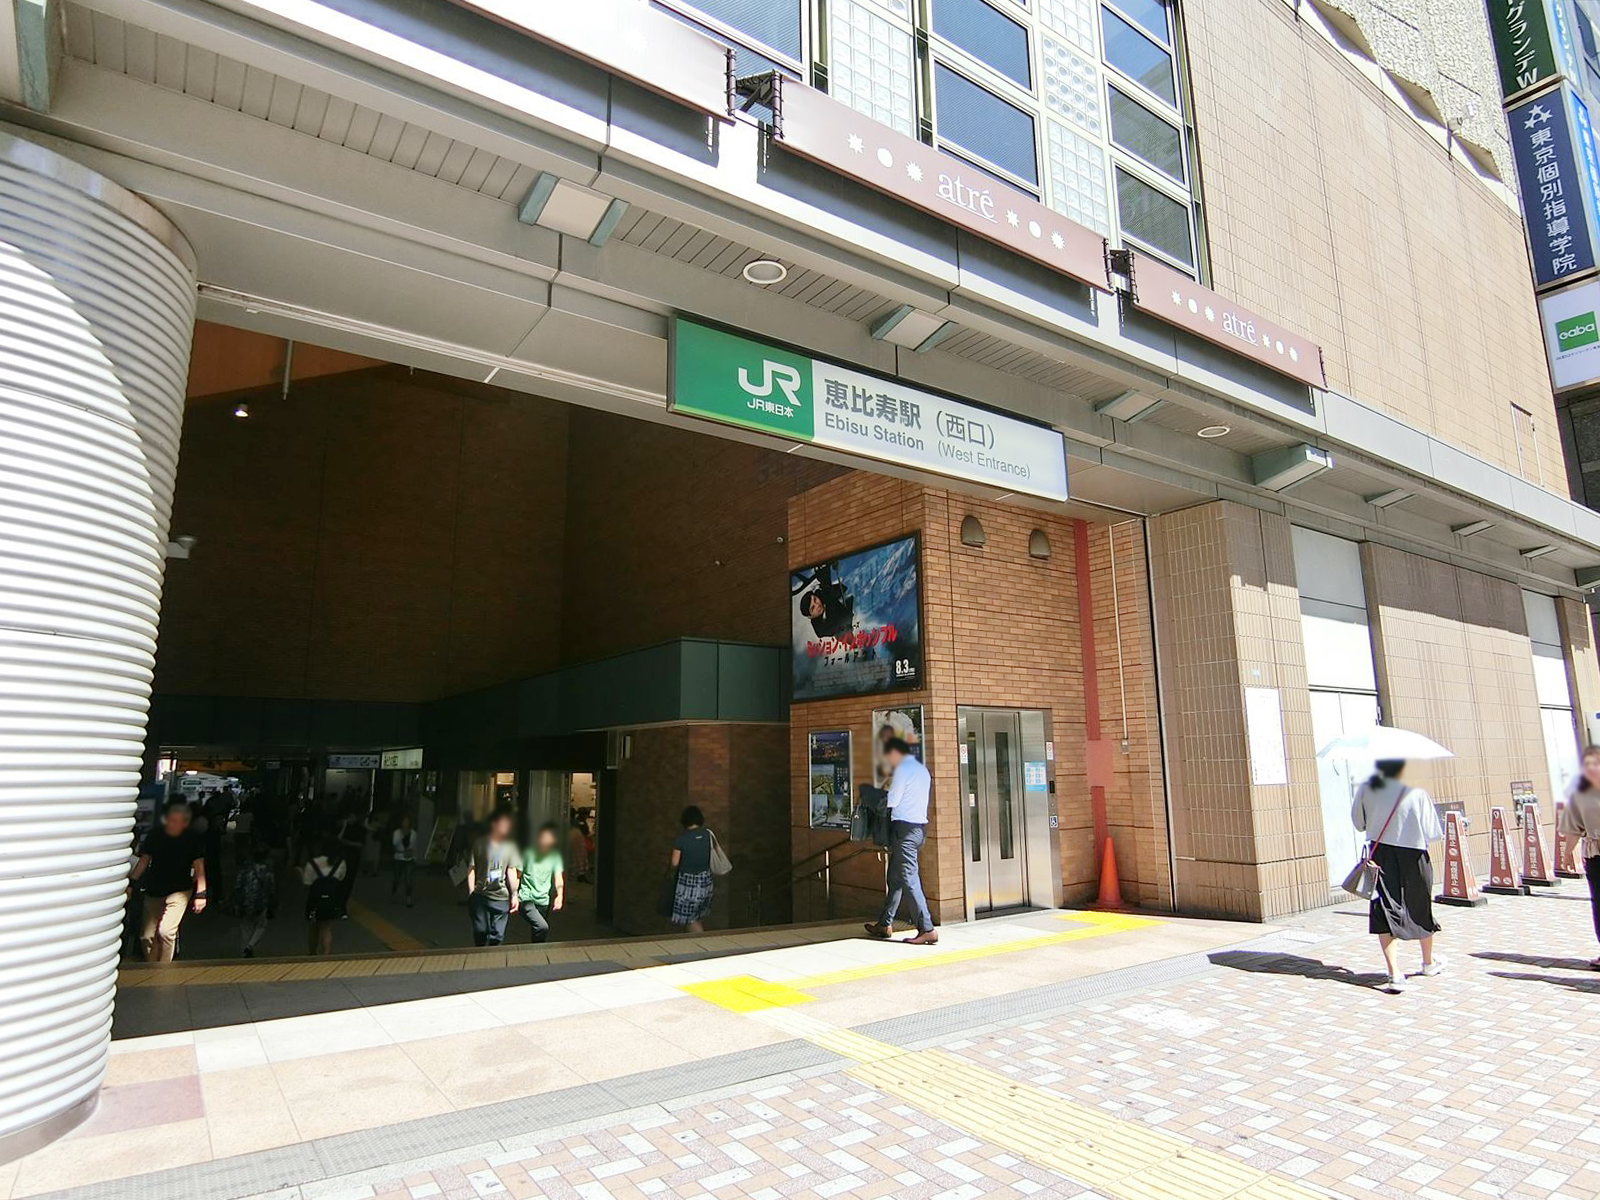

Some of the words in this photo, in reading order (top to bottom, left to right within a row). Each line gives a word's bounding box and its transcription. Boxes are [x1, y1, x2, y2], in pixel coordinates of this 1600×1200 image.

[1505, 0, 1538, 89] グランデW
[937, 172, 997, 222] atré
[1529, 127, 1577, 275] 東京個別指導学院
[1222, 311, 1257, 345] atré
[738, 359, 802, 406] JR
[747, 397, 794, 418] JR東日本
[824, 378, 922, 430] 恵比寿駅
[936, 410, 995, 449] （西口）
[824, 412, 869, 437] Ebisu
[873, 424, 924, 451] Station
[937, 439, 974, 464] (West
[977, 452, 1031, 480] Entrance)
[895, 659, 910, 674] 8.3
